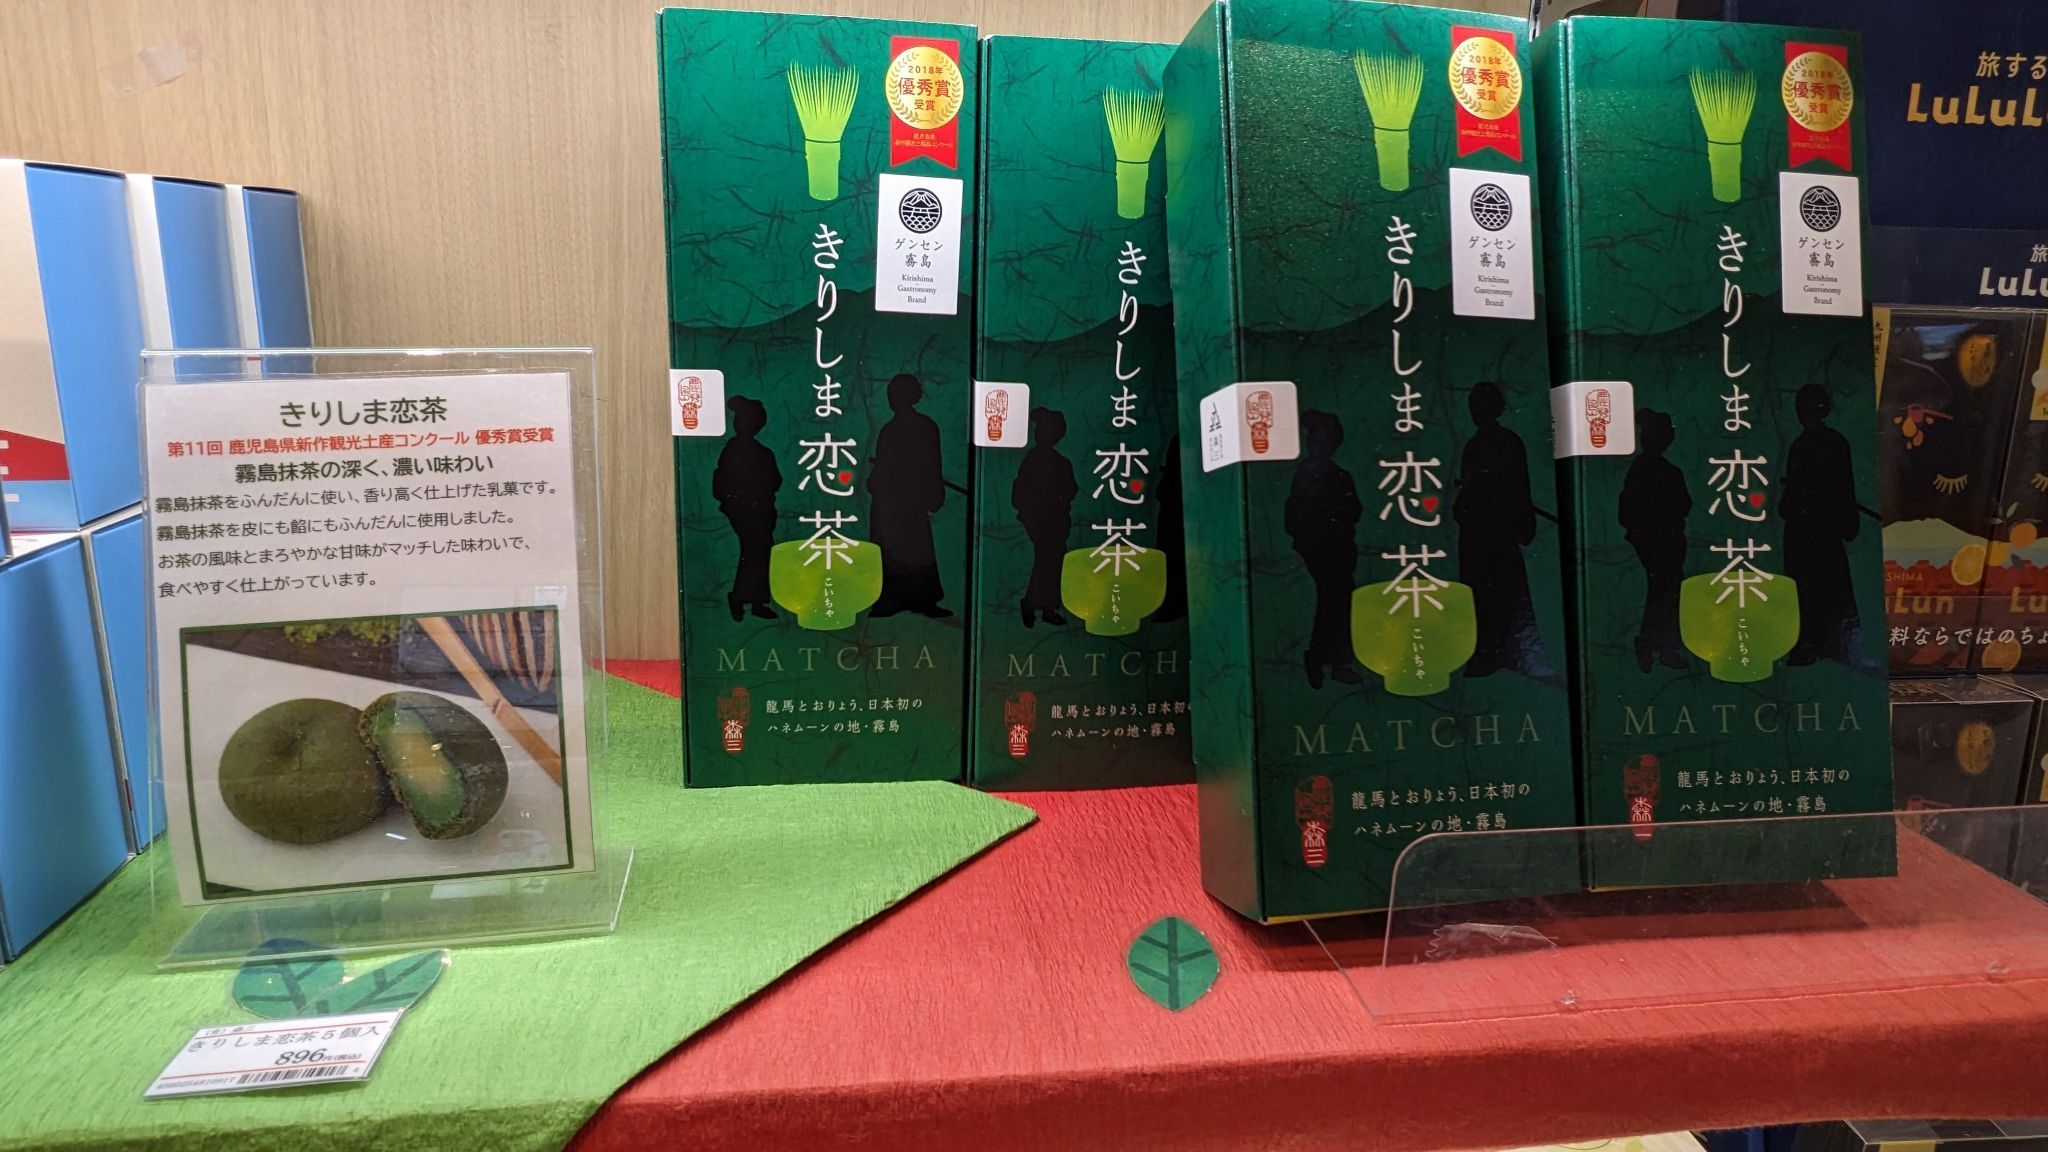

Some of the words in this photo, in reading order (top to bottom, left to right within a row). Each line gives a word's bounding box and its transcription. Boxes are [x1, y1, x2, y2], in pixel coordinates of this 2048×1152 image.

[1469, 54, 1502, 65] 2018年
[1976, 51, 2048, 80] 旅する
[908, 66, 943, 76] 2018年
[1461, 66, 1510, 89] 優秀賞
[898, 77, 951, 98] 優秀賞
[1476, 89, 1497, 101] 受賞
[1793, 81, 1842, 101] 優秀賞
[913, 99, 936, 112] 受賞
[1808, 102, 1829, 114] 受賞
[1907, 83, 2048, 128] LuLuL
[895, 238, 944, 251] ゲンセン
[1468, 236, 1516, 250] ゲンセン
[1798, 236, 1844, 250] ゲンセン
[905, 252, 932, 268] 霧島
[902, 274, 934, 283] Kirishima
[1477, 275, 1509, 284] Kirishima
[1807, 274, 1838, 283] Kirishima
[897, 285, 937, 295] Gastronomy
[1474, 286, 1513, 297] Gastronomy
[1803, 286, 1841, 296] Gastronomy
[907, 295, 927, 304] Brand
[1485, 299, 1504, 307] Brand
[1814, 296, 1832, 305] Brand
[279, 397, 448, 428] きりしま恋茶
[167, 440, 223, 457] 第11回
[229, 431, 470, 455] 鹿児島県新作観光土産コンクール
[475, 427, 554, 444] 優秀賞受賞
[235, 455, 494, 484] 霧島抹茶の深く、濃い味わい
[155, 481, 558, 513] 霧島抹茶をふんだんに使い、香り高く仕上げた乳菓です。
[156, 510, 514, 542] 霧島抹茶を皮にも餡にもふんだんに使用しました。
[158, 537, 530, 569] お茶の風味とまろやかな甘味がマッチした味わいで、
[158, 571, 377, 599] 食べやすく仕上がっています。
[1885, 587, 1954, 614] Lun
[717, 645, 936, 672] MATCHA
[1007, 651, 1179, 678] MATCH
[766, 697, 923, 714] 龍馬とおりょう、日本初の
[767, 719, 900, 734] ハネムーンの地・霧島
[1623, 702, 1862, 735] MATCHA
[1051, 722, 1176, 738] ハネムーンの地・霧島
[1293, 712, 1542, 756] MATCHA
[1677, 767, 1850, 788] 龍馬とおりょう、日本初の
[1351, 782, 1530, 810] 龍馬とおりょう、日本初の
[1680, 795, 1826, 814] ハネムーンの地・霧島
[1354, 812, 1507, 837] ハネムーンの地・霧島
